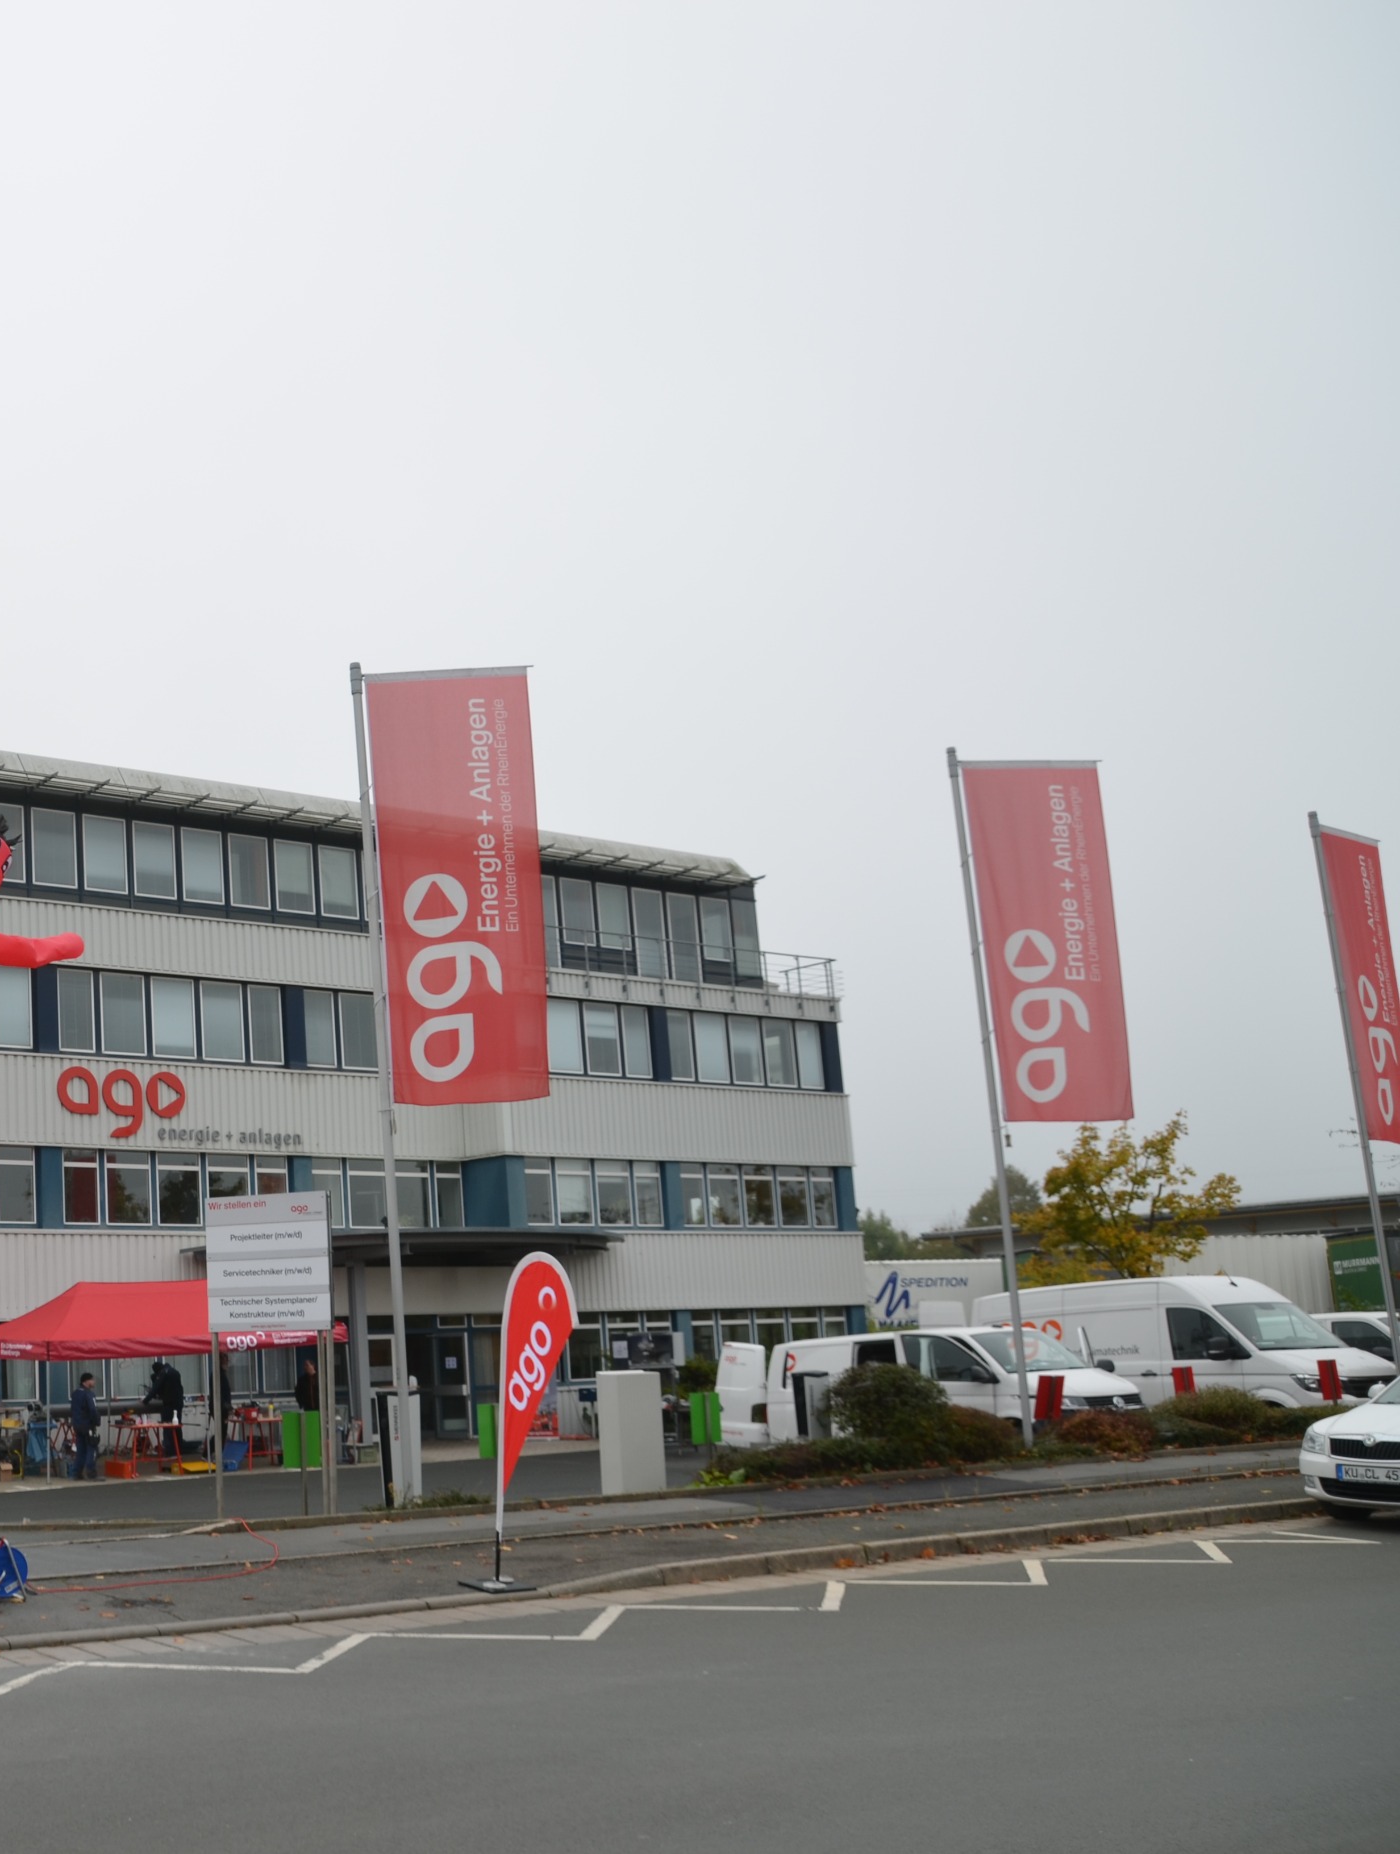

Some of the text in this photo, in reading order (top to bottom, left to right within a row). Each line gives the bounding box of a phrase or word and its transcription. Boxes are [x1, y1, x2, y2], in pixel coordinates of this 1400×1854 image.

[467, 698, 502, 933] Energie + Anlagen
[492, 698, 519, 932] Ein Unternehmen der RheinEnergie
[1048, 784, 1086, 981] Energie + Anlagen
[1071, 786, 1100, 982] Ein Unternehmen der RheinEnergie
[1358, 855, 1375, 930] Anlagen
[403, 873, 503, 1083] ago
[1374, 953, 1391, 1023] Energie
[1004, 929, 1090, 1103] ago
[1358, 975, 1398, 1126] ago
[57, 1066, 186, 1138] ago
[158, 1126, 220, 1146] energie
[239, 1127, 302, 1149] anlagen
[208, 1199, 267, 1211] Wir stellen ein
[230, 1231, 302, 1242] Projektleiter (m/w/d)
[291, 1205, 308, 1214] ago
[220, 1296, 318, 1306] Technischer Systemplaner/
[223, 1266, 312, 1277] Servicetechniker (m/w/d)
[900, 1277, 968, 1288] SPEDITION
[227, 1335, 257, 1350] ago
[229, 1309, 305, 1319] Konstrukteur (m/w/d)
[508, 1321, 552, 1411] ago
[1344, 1468, 1358, 1478] KU
[1364, 1469, 1379, 1479] CL
